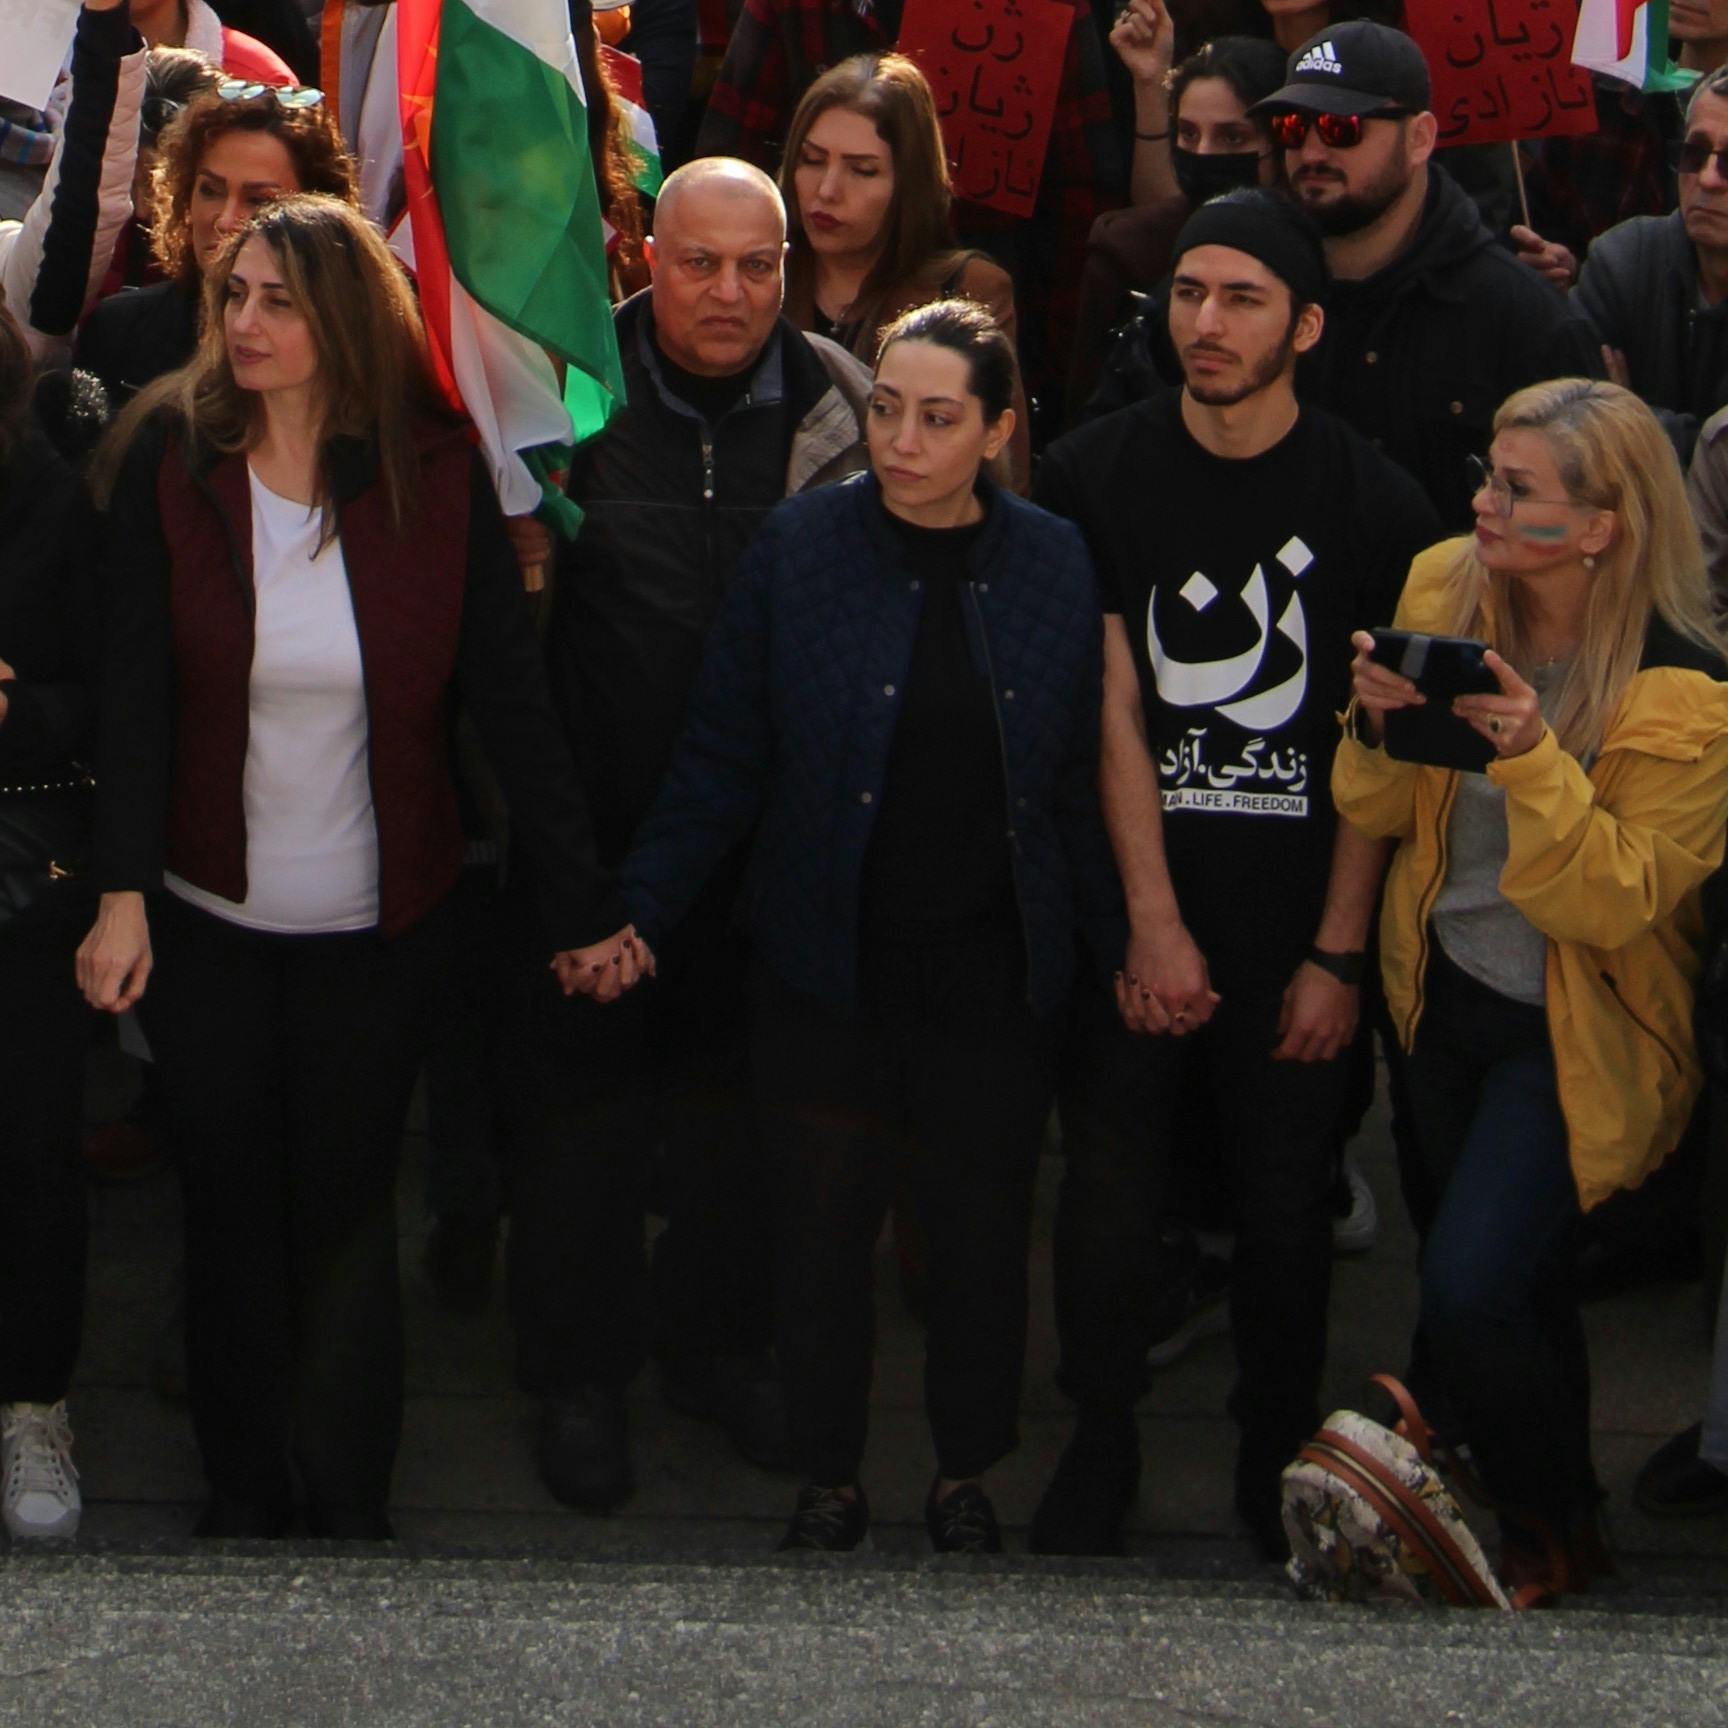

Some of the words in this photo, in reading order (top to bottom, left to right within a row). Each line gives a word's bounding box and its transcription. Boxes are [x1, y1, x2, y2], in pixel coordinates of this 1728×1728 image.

[1296, 57, 1342, 74] adidas
[1146, 535, 1315, 731] زن
[1193, 792, 1223, 808] LIFE
[1233, 795, 1304, 813] FREEDOM
